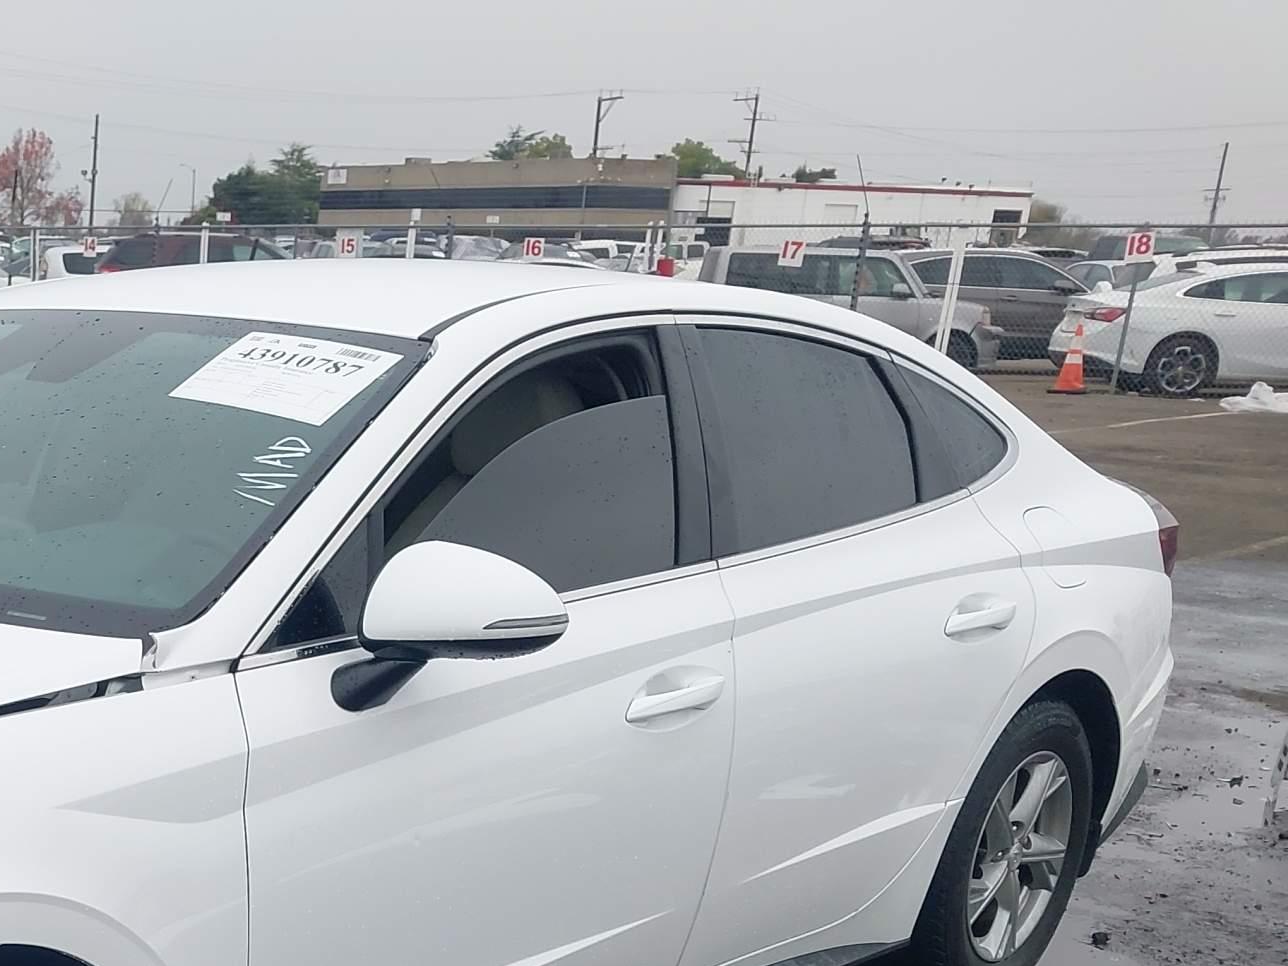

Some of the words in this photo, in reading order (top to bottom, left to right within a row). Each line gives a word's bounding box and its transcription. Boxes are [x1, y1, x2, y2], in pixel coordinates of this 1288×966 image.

[84, 238, 96, 252] 14
[340, 238, 355, 254] 15
[524, 239, 542, 256] 16
[781, 241, 805, 259] 17
[1127, 233, 1152, 256] 18
[237, 346, 365, 378] 43910787
